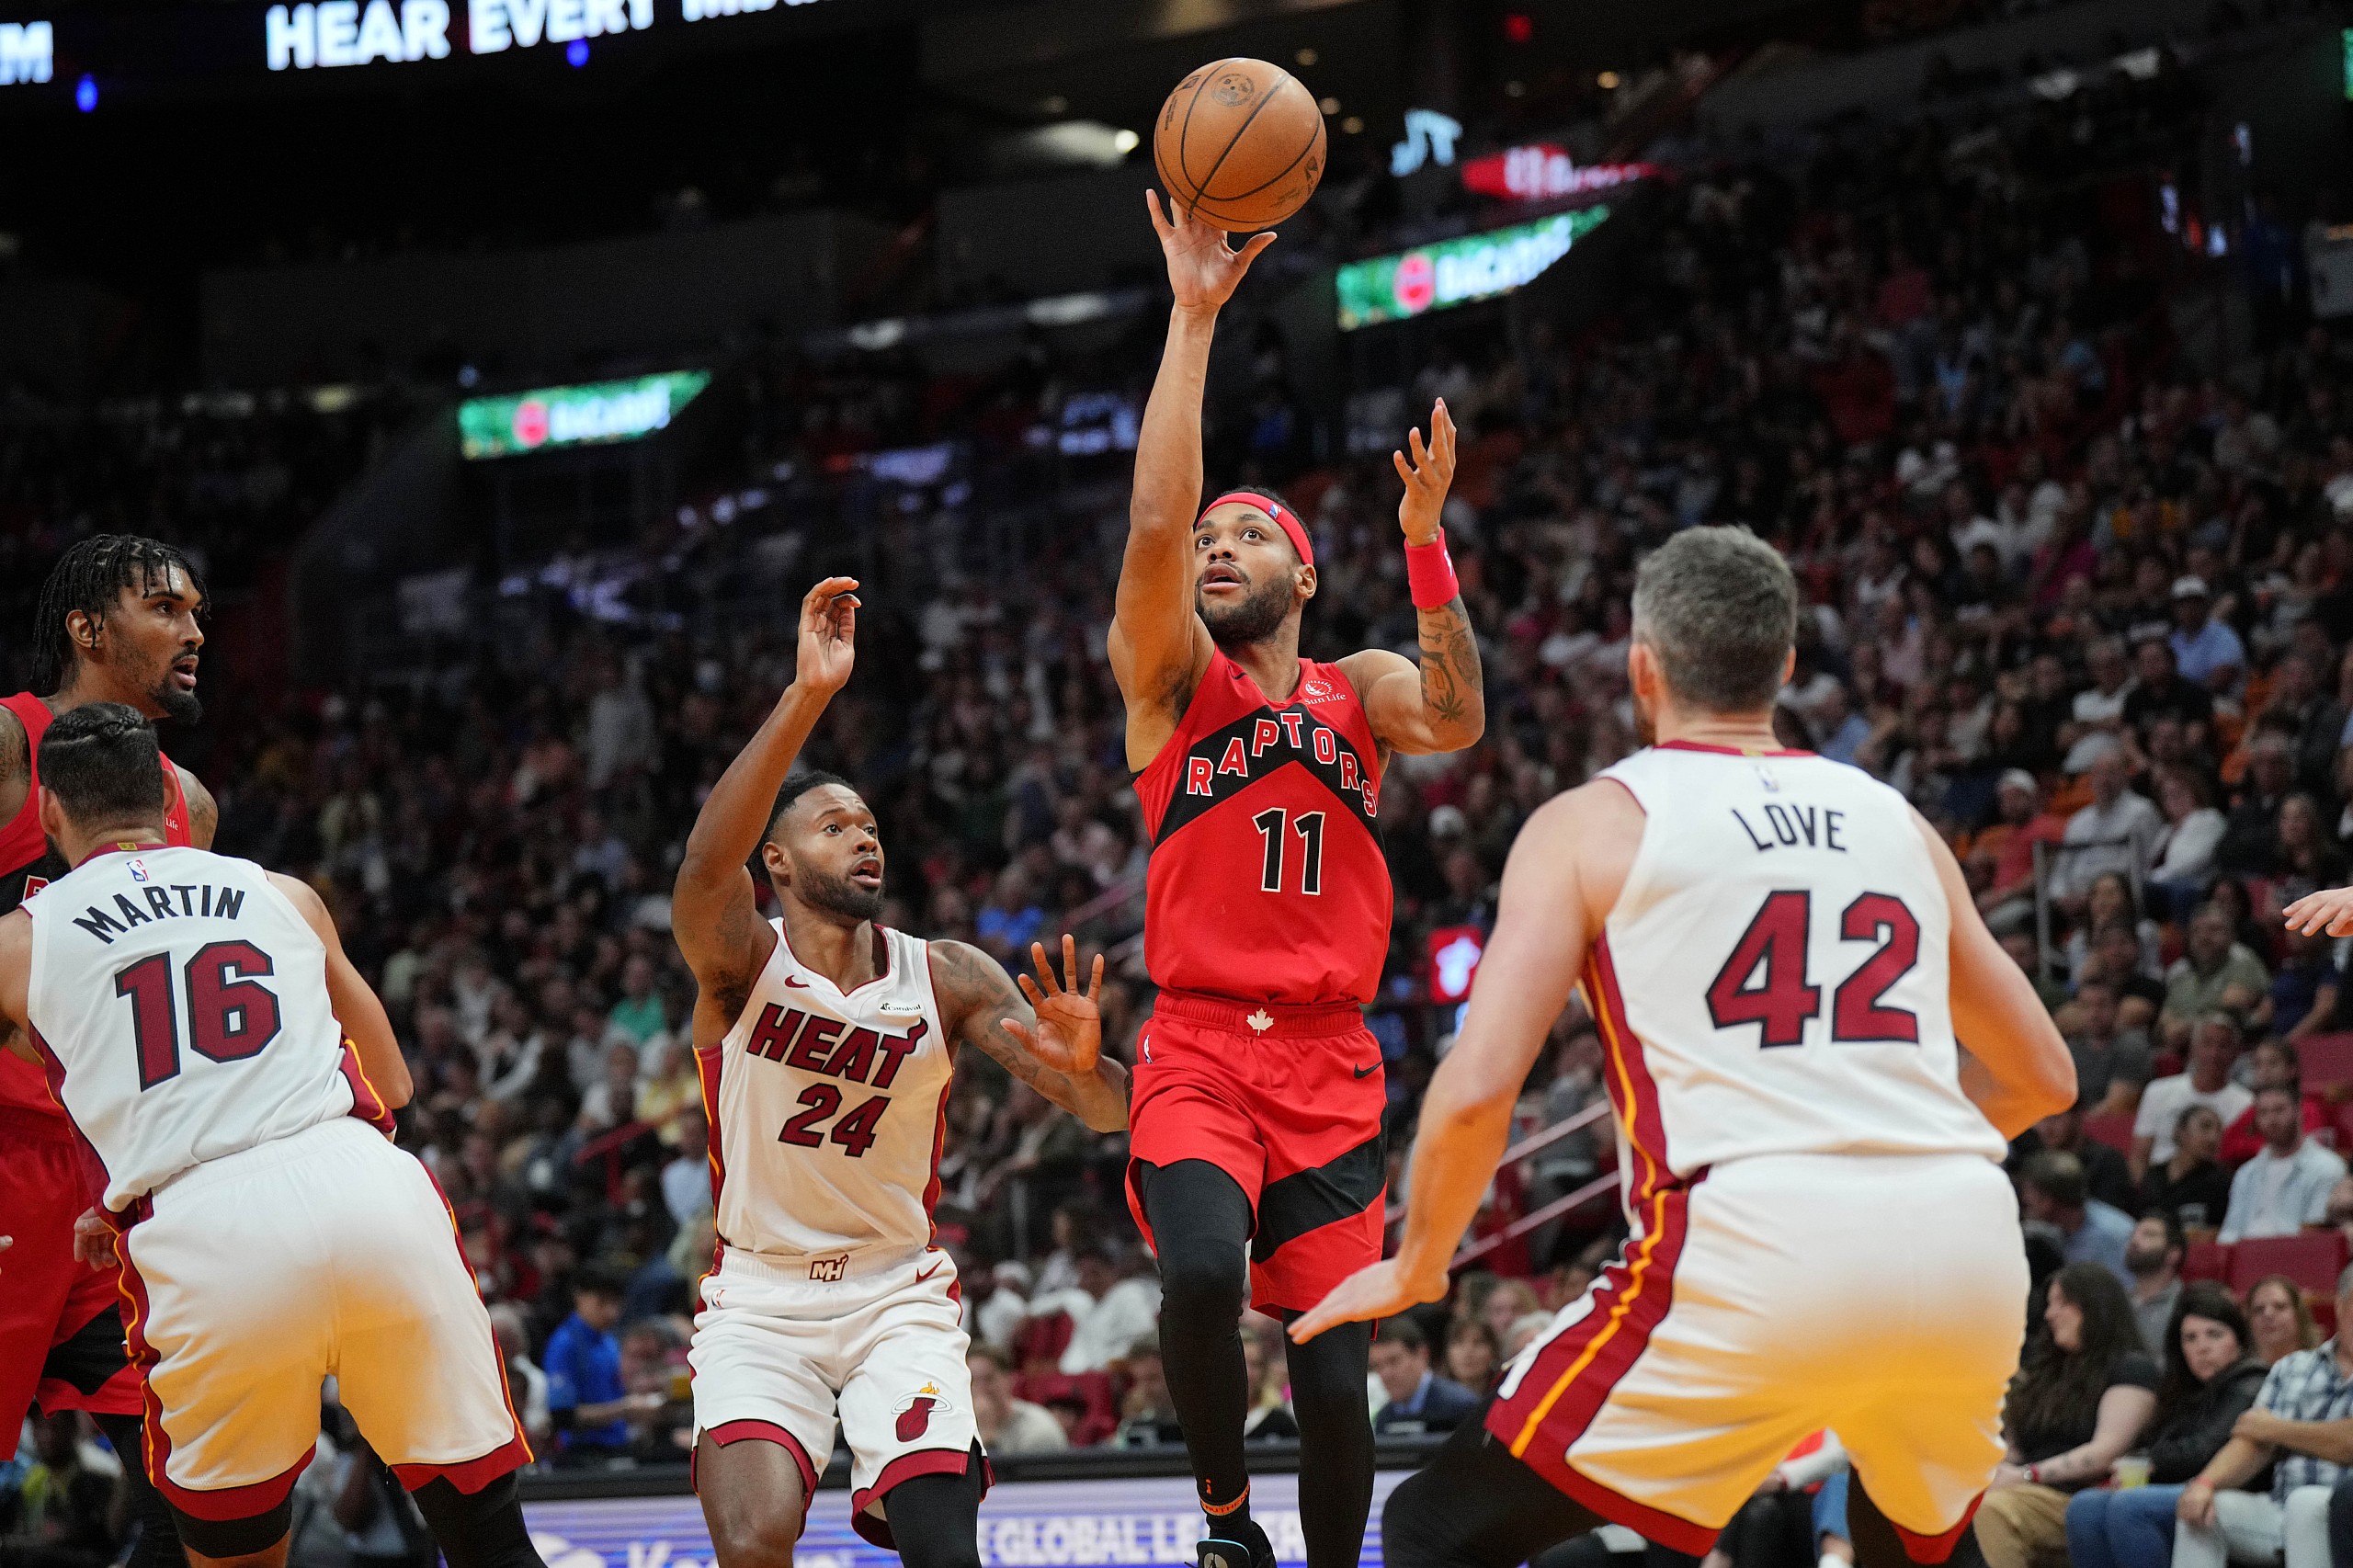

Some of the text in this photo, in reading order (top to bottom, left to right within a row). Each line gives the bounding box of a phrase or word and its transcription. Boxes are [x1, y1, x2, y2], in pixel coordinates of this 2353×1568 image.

[266, 0, 451, 71] HEAR
[1326, 692, 1347, 701] Life
[1186, 712, 1377, 817] RAPTORS
[165, 817, 178, 831] Life
[1252, 807, 1325, 895] 11
[1732, 803, 1846, 851] LOVE
[73, 884, 244, 944] MARTIN
[1705, 889, 1920, 1049] 42
[115, 939, 281, 1092] 16
[745, 1001, 928, 1089] HEAT
[778, 1082, 892, 1158] 24
[991, 1517, 1153, 1564] GLOBAL
